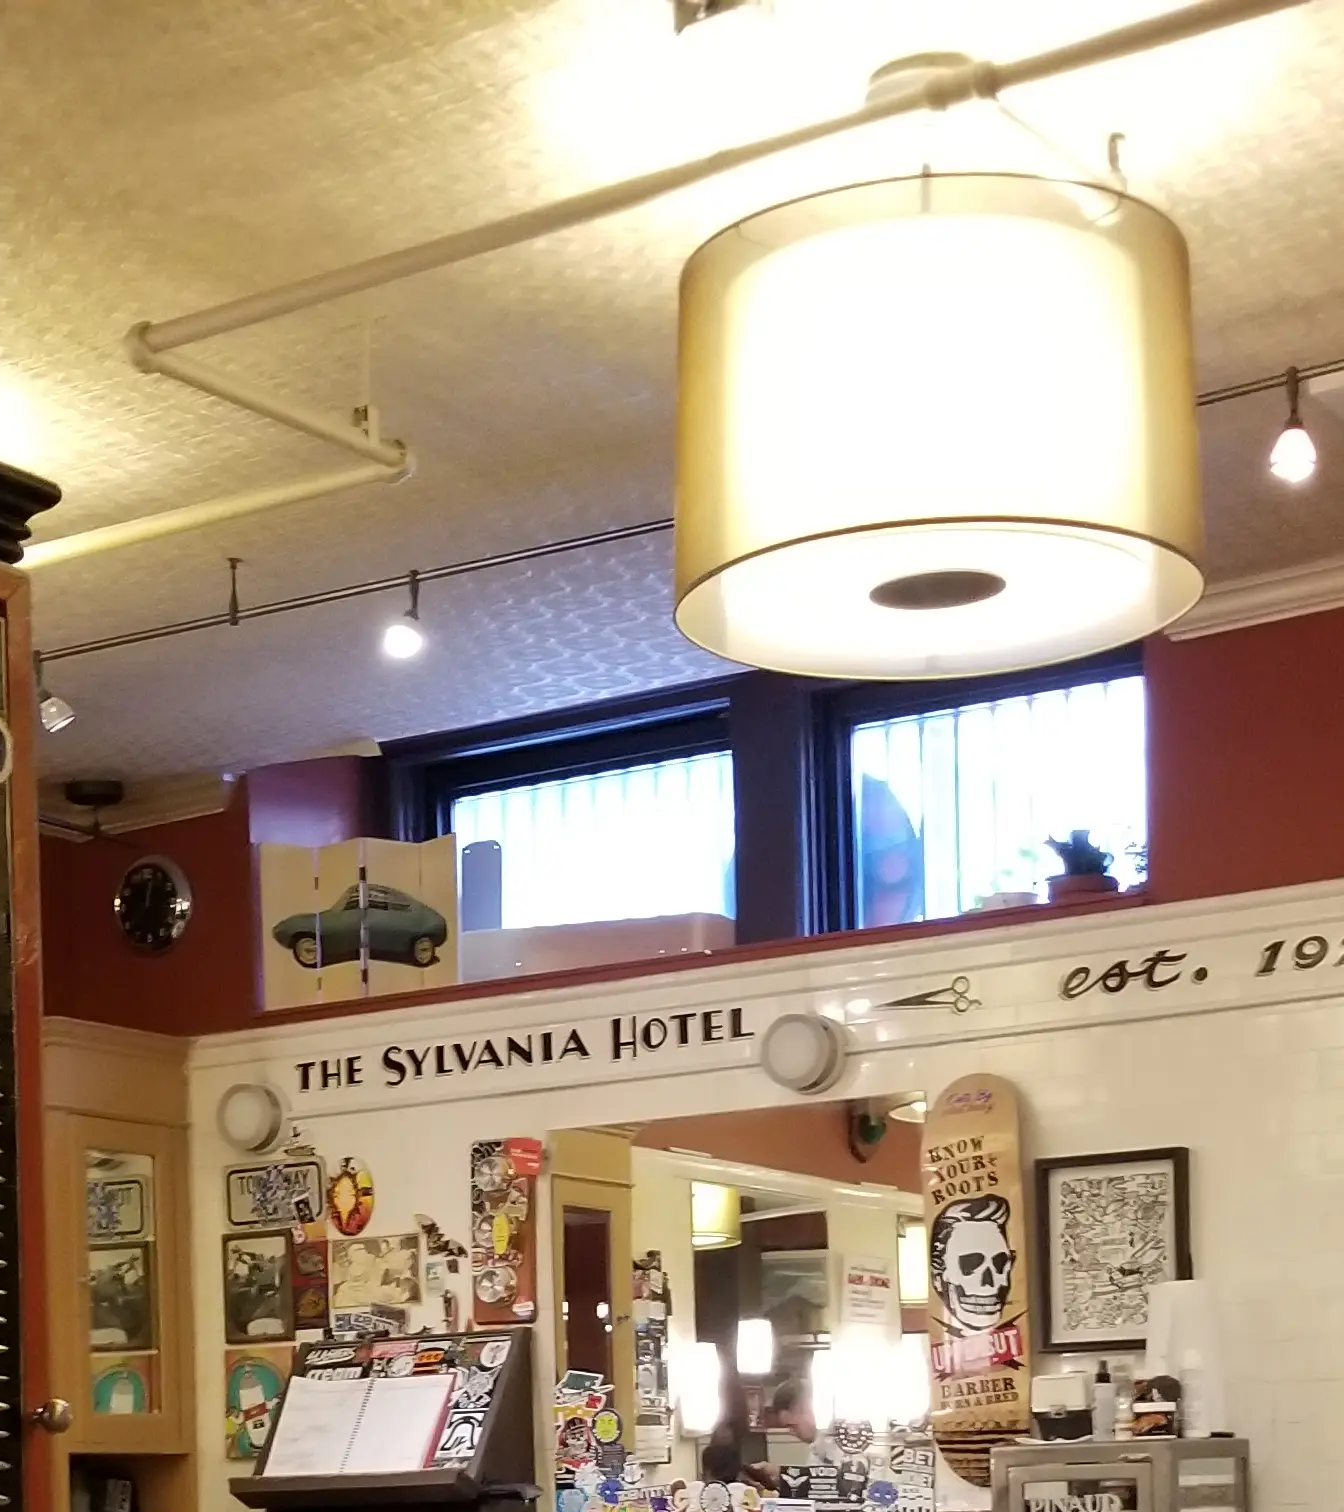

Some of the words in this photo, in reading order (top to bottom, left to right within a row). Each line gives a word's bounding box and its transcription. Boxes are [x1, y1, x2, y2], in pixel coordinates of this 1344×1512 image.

[1059, 947, 1209, 1000] est.
[295, 1054, 364, 1093] THE
[383, 1028, 591, 1088] SYLVANIA
[611, 1008, 755, 1063] HOTEL
[928, 1136, 984, 1163] KNOW
[934, 1155, 986, 1183] YOUR
[931, 1171, 999, 1205] ROOTS
[940, 1377, 1016, 1399] BARBER
